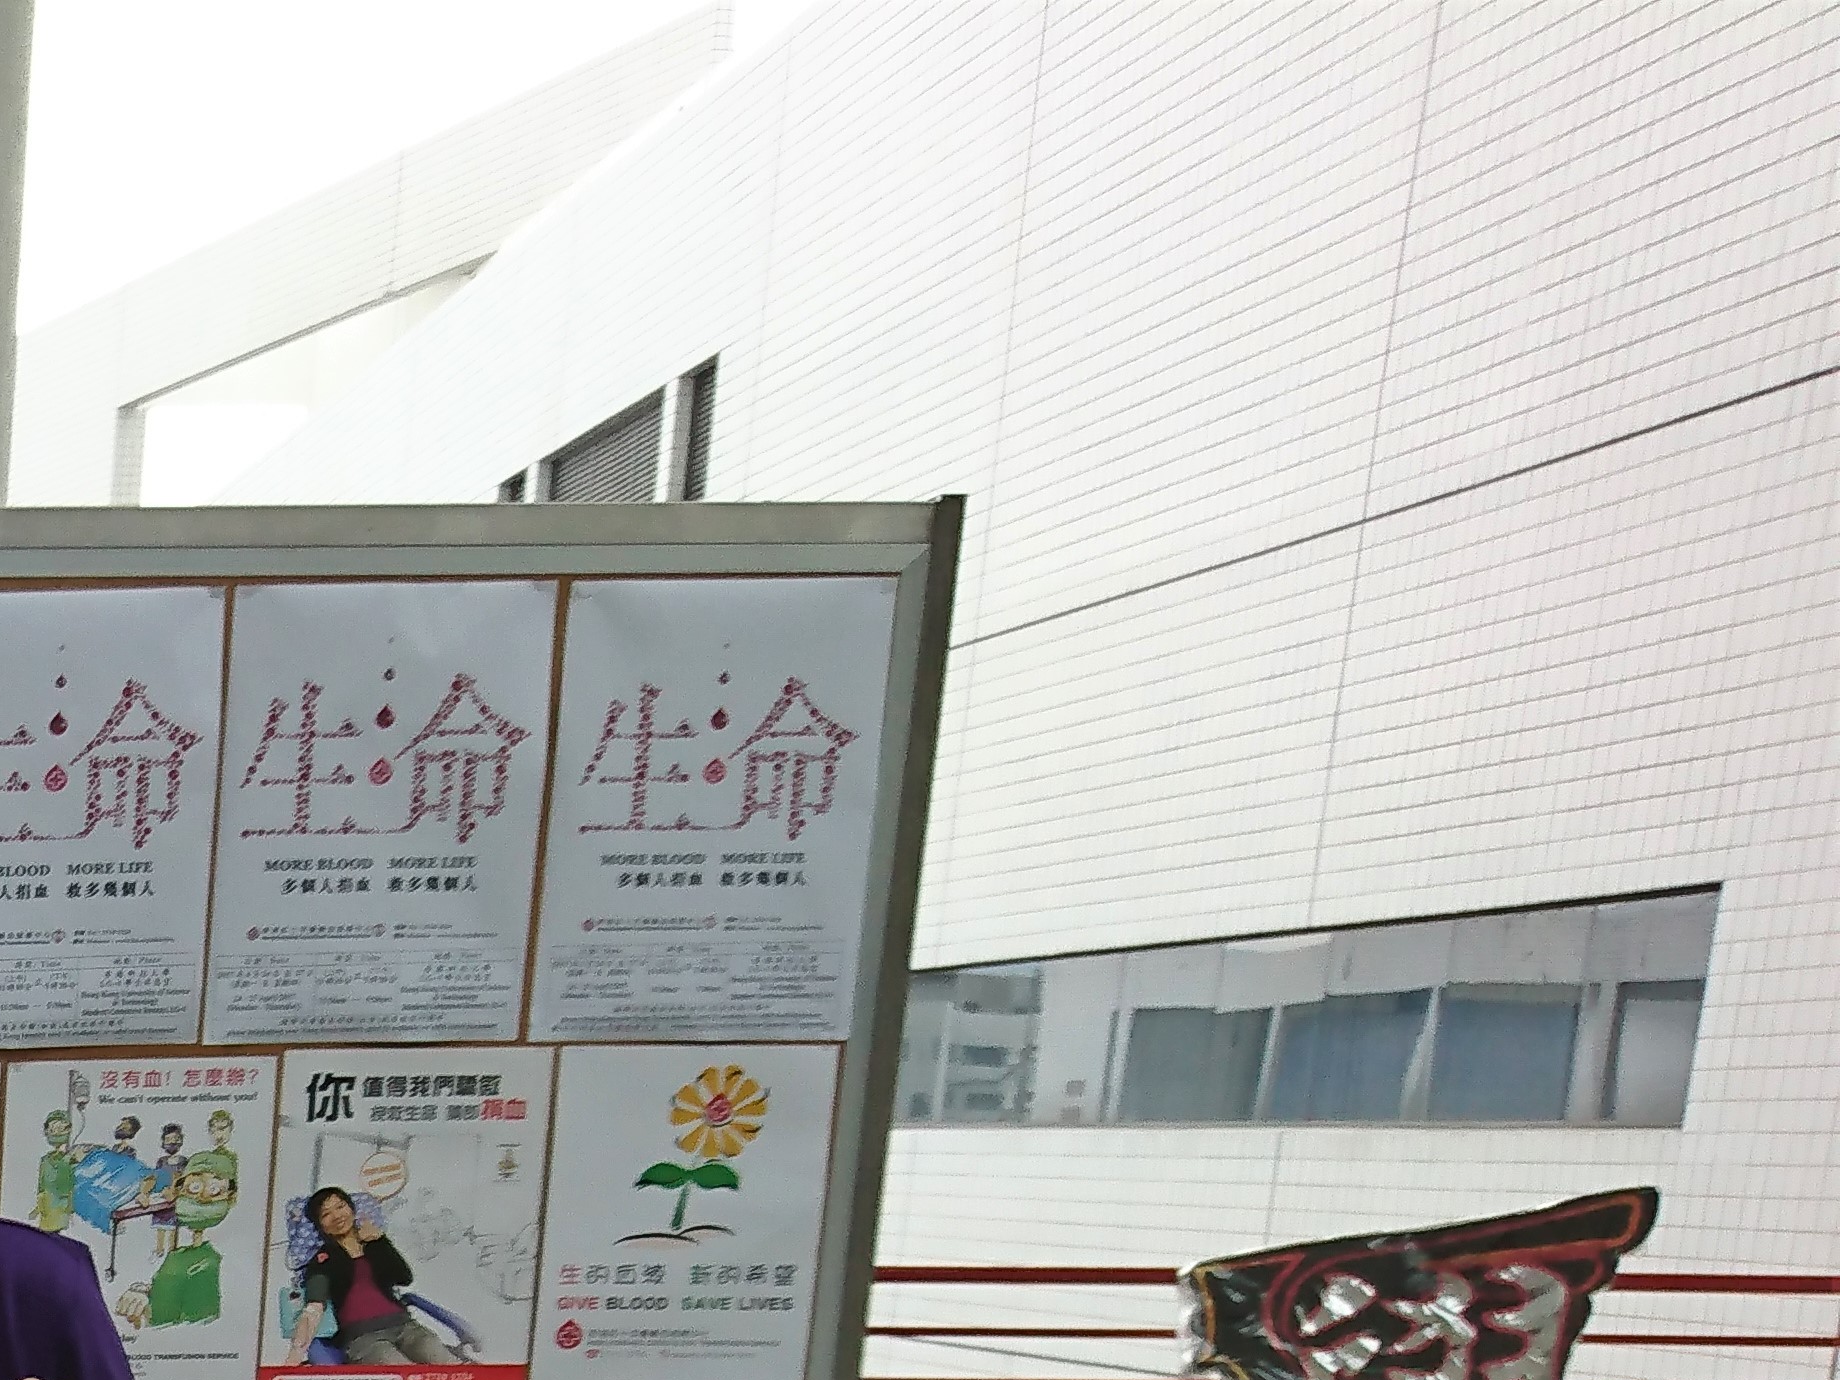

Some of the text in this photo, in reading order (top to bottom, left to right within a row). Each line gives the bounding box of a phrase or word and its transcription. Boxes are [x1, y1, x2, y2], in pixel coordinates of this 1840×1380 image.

[236, 671, 535, 848] 生命
[575, 673, 866, 844] 生命
[264, 856, 478, 871] MORE BLOOD MORE LIFE
[600, 852, 805, 865] MORE BLOOD MORE LIFE
[68, 862, 115, 875] MORE
[119, 861, 153, 873] LIFE
[282, 875, 477, 894] 多個人捐血 救多幾個人
[618, 871, 806, 888] 多個人捐血 救多幾個人
[67, 881, 153, 898] 救多幾個人
[306, 1073, 357, 1122] 你
[605, 1297, 669, 1310] BLOOD
